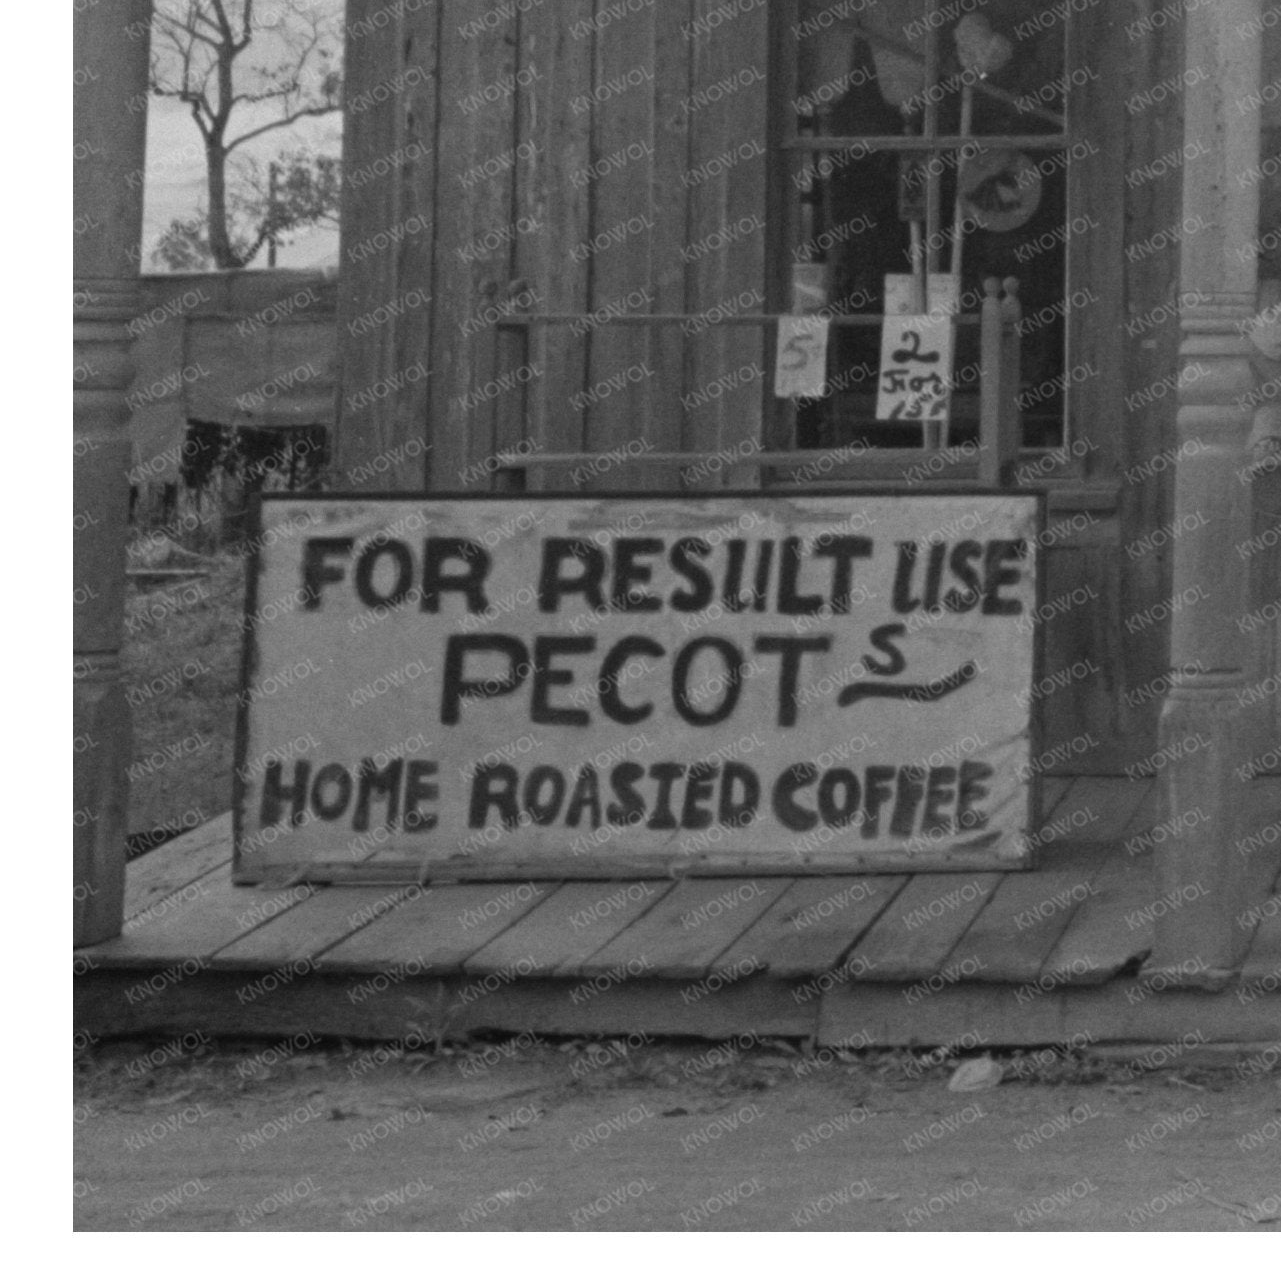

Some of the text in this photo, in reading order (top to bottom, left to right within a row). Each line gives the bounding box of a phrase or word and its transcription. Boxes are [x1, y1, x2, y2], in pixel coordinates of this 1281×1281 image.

[892, 329, 940, 364] 2
[299, 534, 1027, 617] FOR RESULT USE
[259, 756, 995, 840] HOME ROASTED COFFEE
